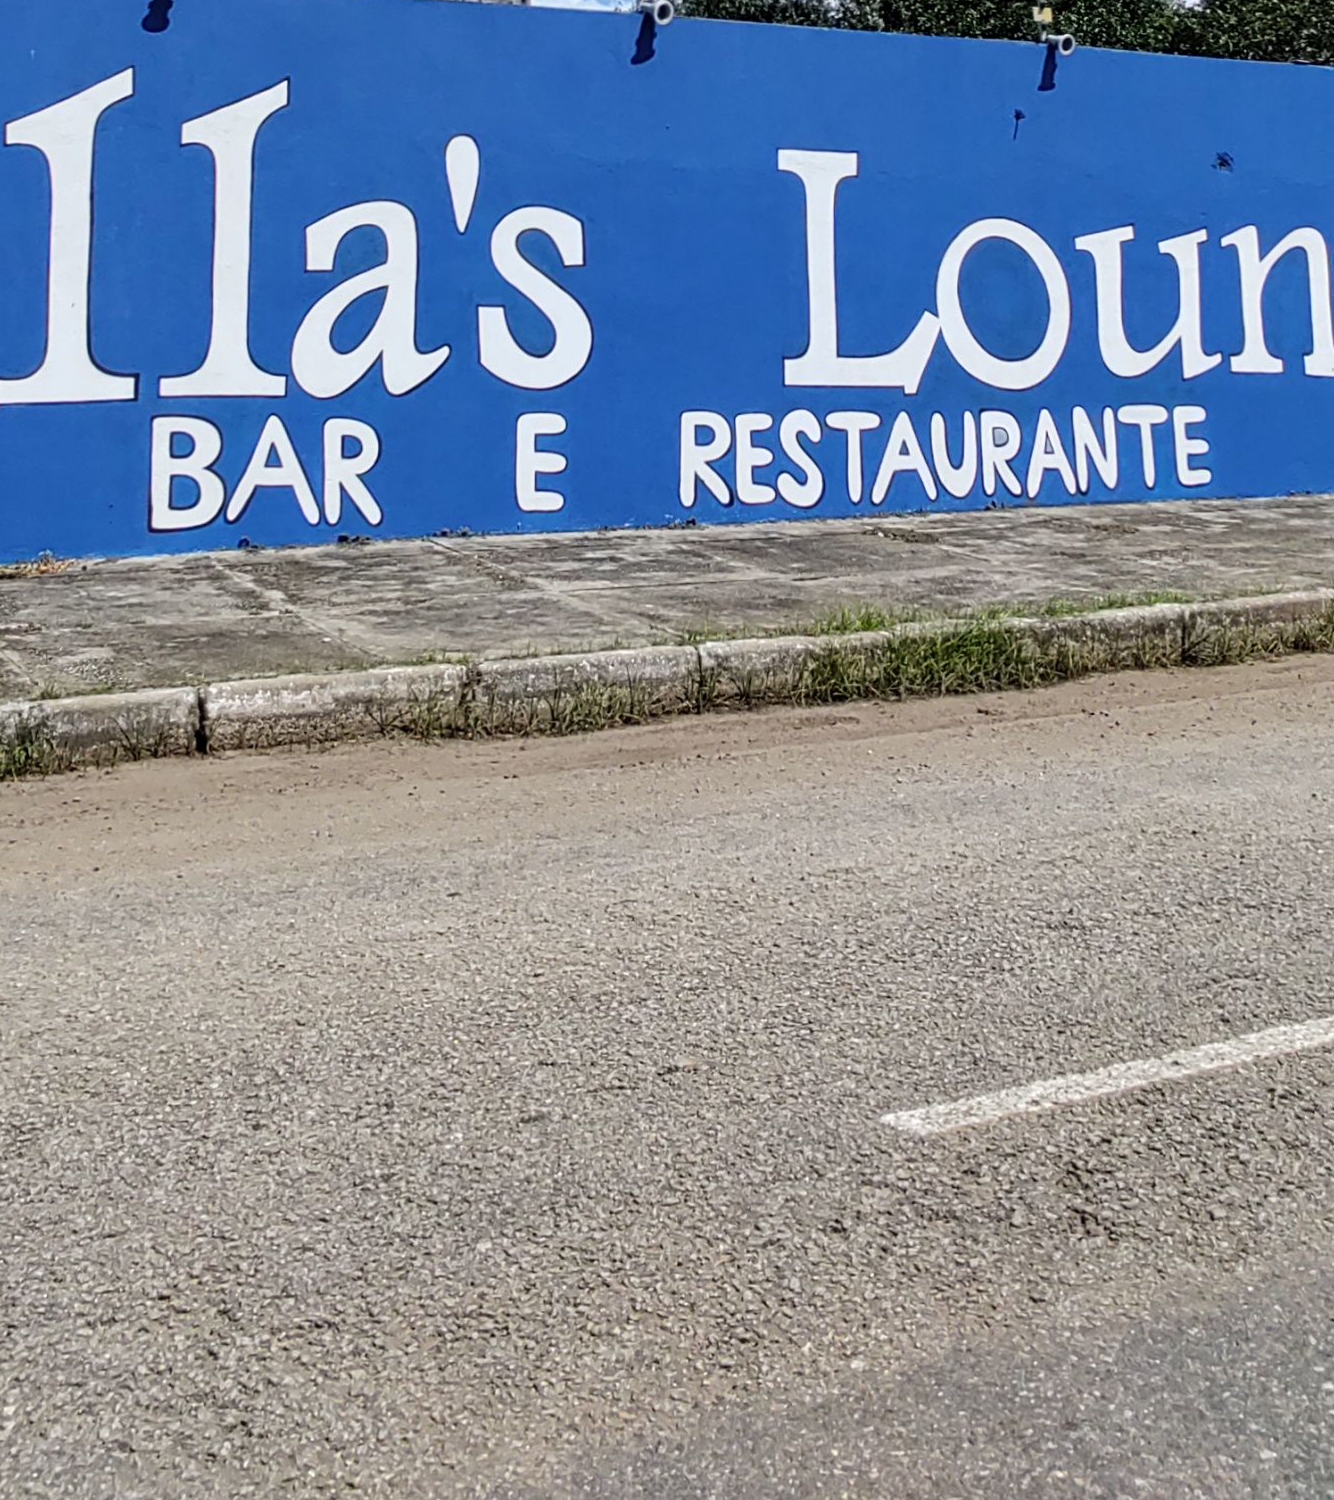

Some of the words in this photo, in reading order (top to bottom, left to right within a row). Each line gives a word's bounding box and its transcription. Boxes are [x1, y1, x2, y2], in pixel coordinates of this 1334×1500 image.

[150, 414, 383, 531] BAR
[514, 411, 568, 512] E
[678, 404, 1213, 508] RESTAURANTE
